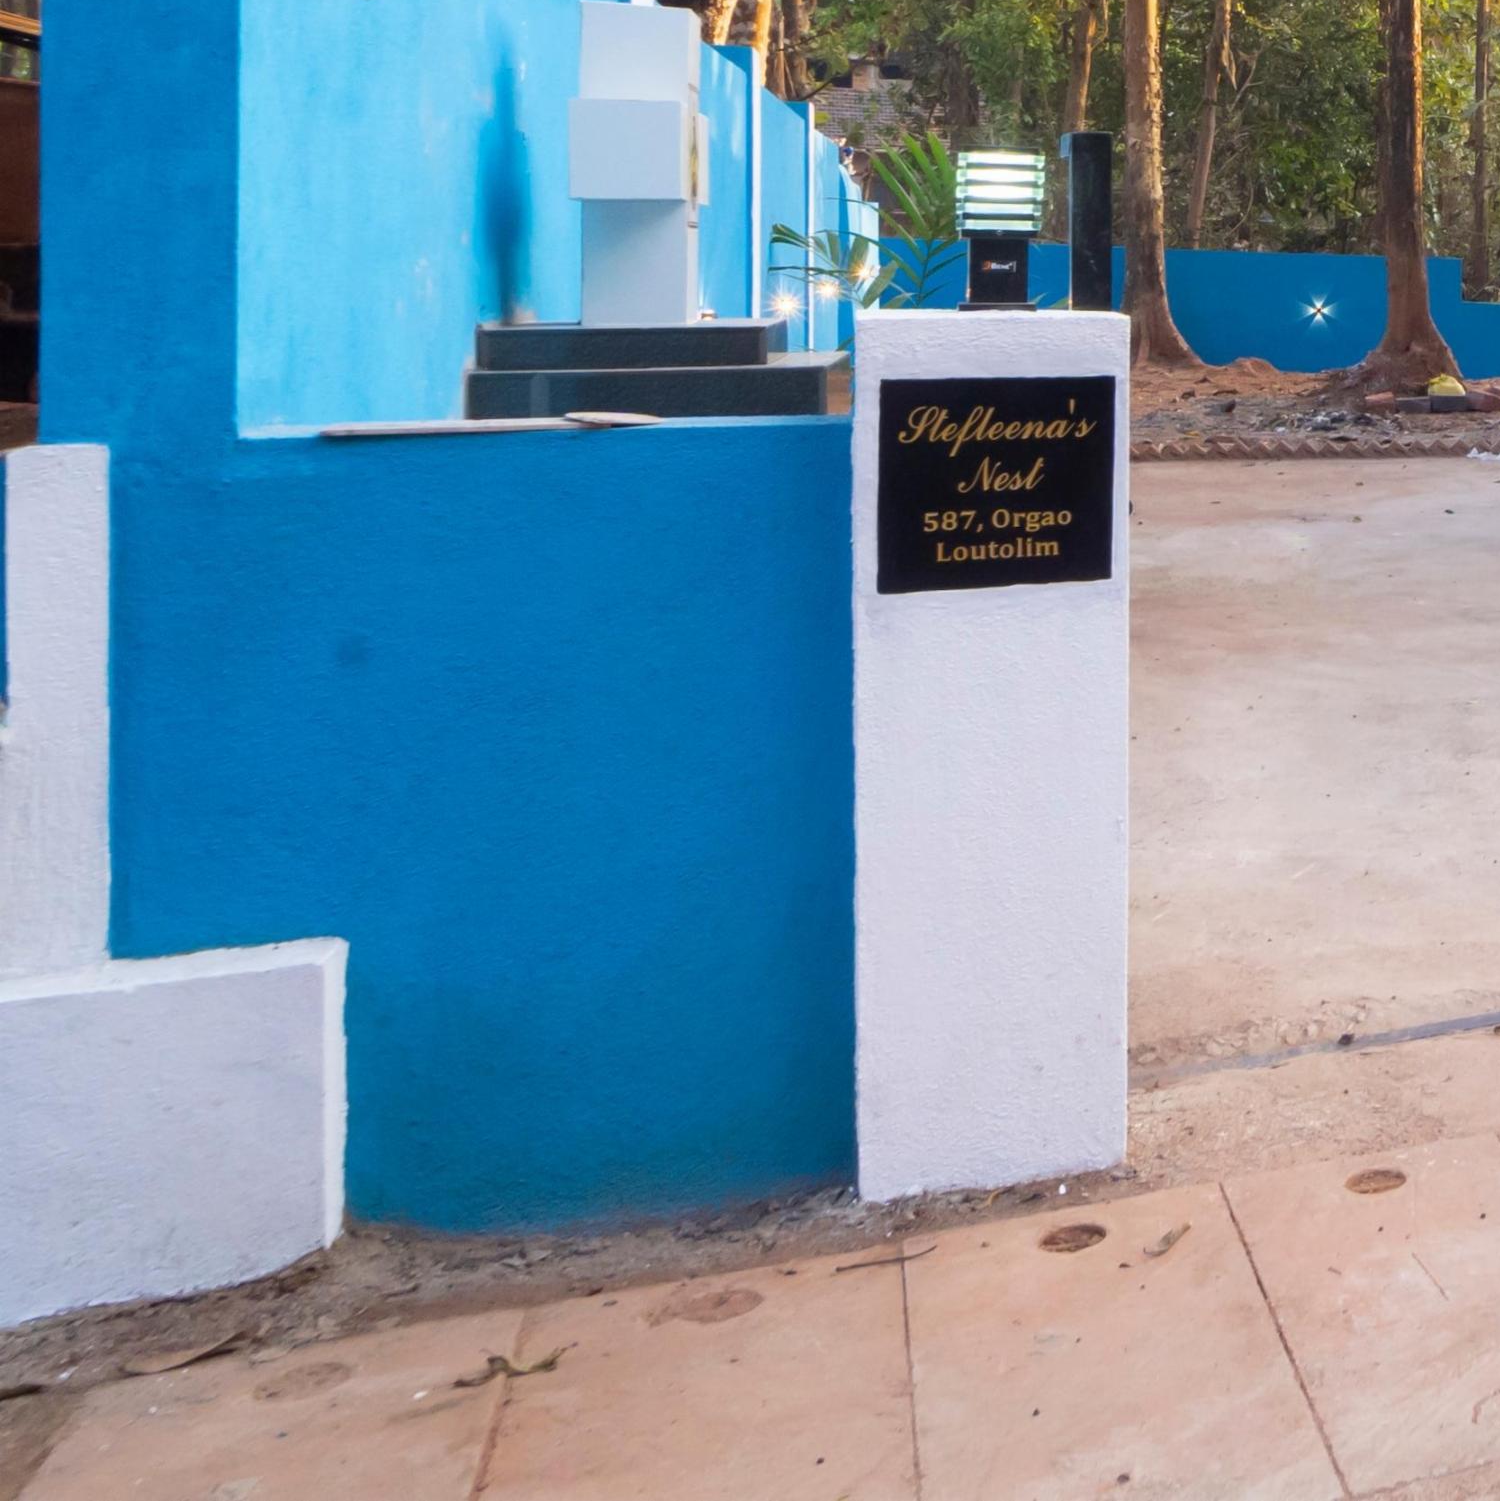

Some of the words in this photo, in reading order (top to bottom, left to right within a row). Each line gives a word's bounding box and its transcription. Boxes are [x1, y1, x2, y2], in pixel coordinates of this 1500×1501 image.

[898, 398, 1097, 457] Stefleena's
[957, 456, 1046, 493] Nest
[923, 510, 983, 533] 587,
[991, 509, 1073, 532] Orgao
[936, 537, 1060, 562] Loutolim
